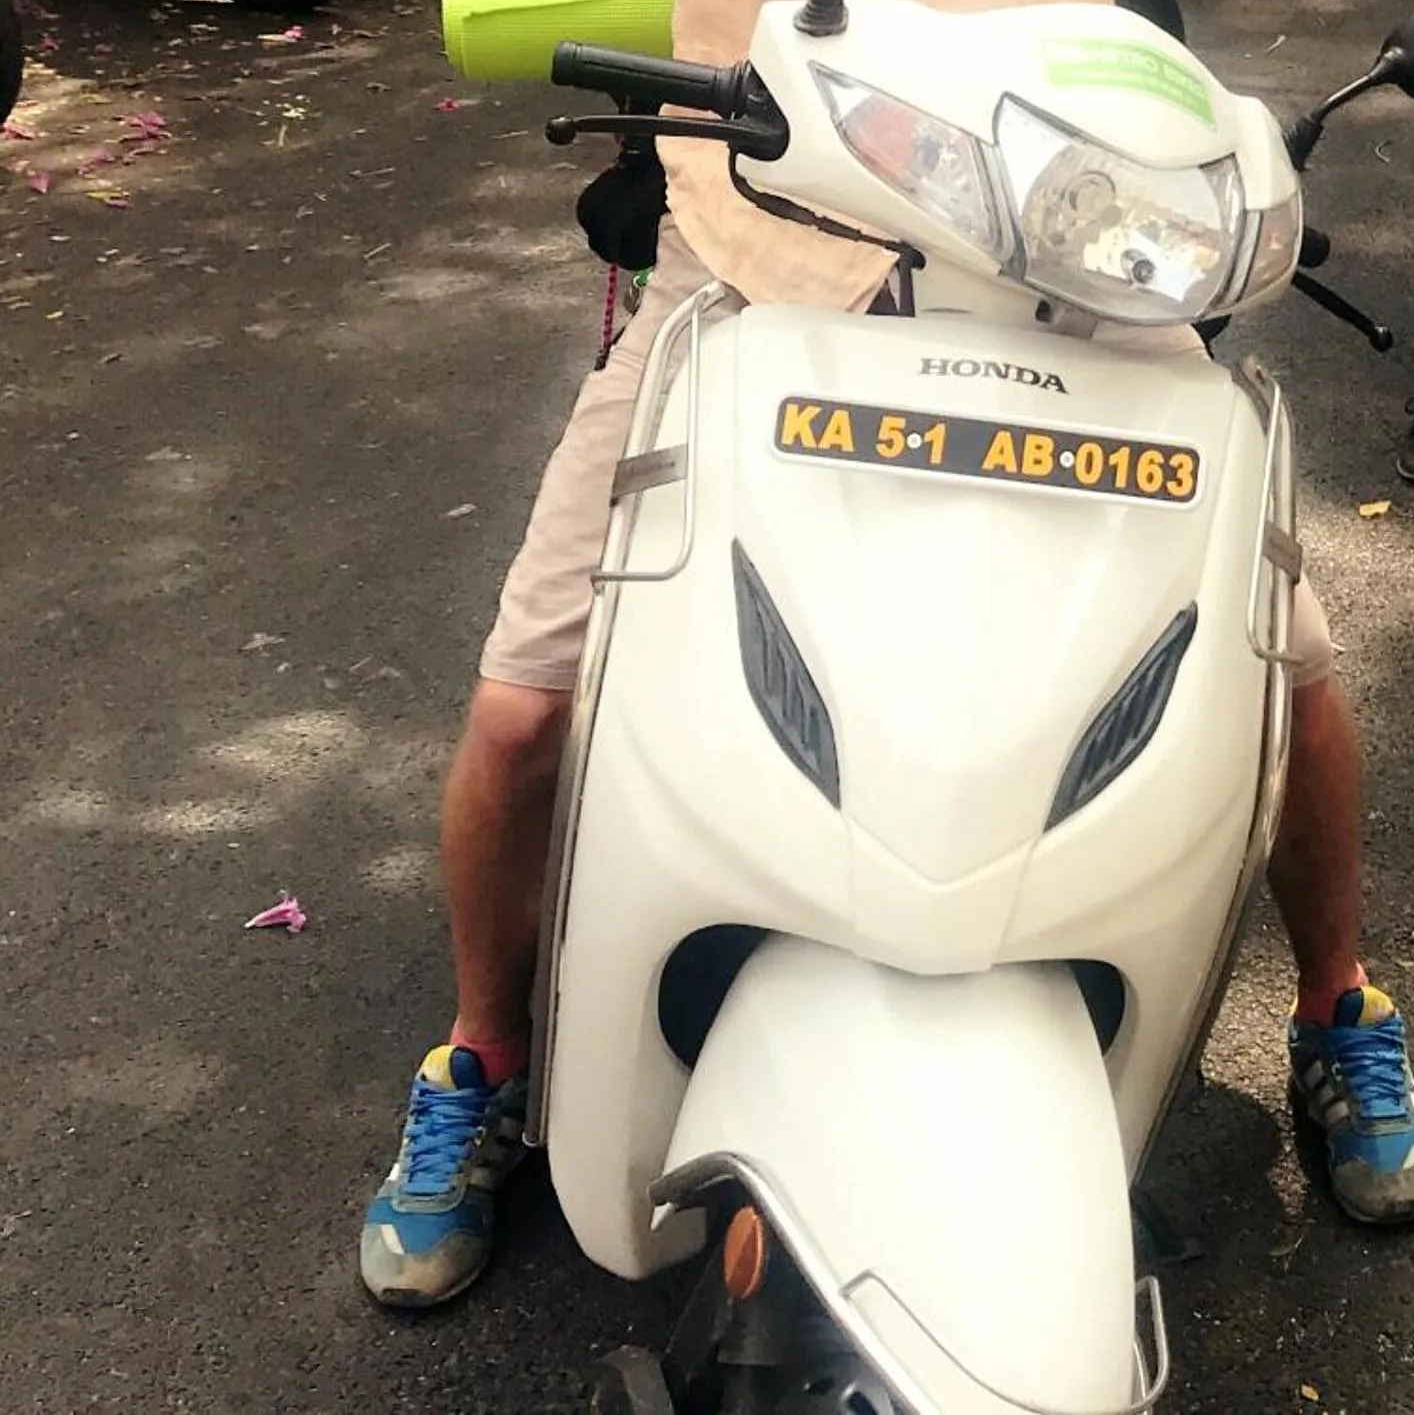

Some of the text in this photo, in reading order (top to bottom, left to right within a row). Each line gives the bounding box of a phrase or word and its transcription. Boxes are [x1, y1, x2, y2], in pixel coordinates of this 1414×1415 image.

[919, 357, 1071, 394] HONDA
[780, 403, 856, 453] KA
[982, 430, 1055, 478] AB
[1074, 441, 1196, 498] 0163
